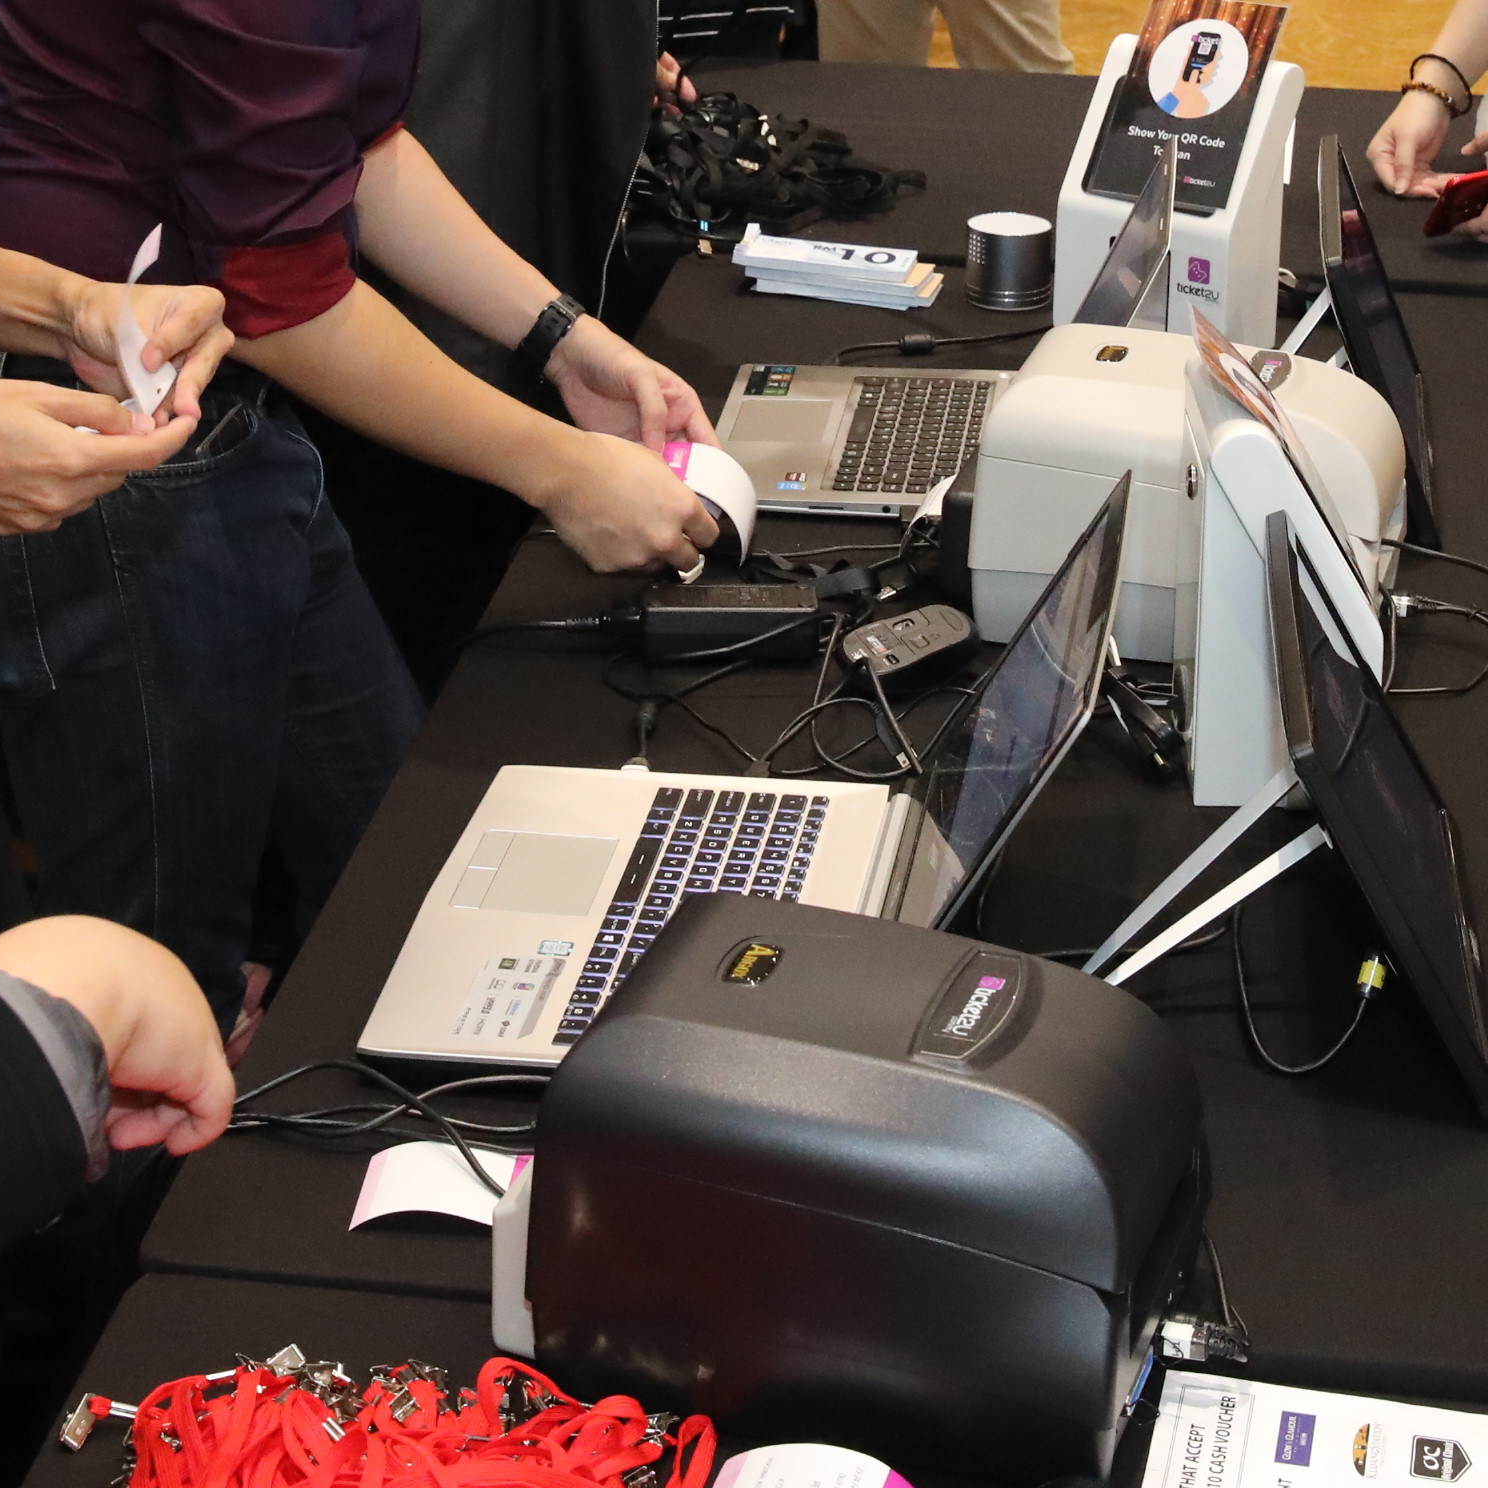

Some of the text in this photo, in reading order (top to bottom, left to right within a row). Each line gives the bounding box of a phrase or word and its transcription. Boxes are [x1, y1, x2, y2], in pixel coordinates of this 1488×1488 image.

[1128, 125, 1156, 139] Show
[1181, 133, 1198, 145] QR
[1199, 136, 1226, 149] Code
[841, 248, 897, 264] 10
[952, 987, 997, 1036] ticket2U
[1215, 1395, 1237, 1444] VOUCHER
[1190, 1423, 1206, 1463] ACCEPT
[1209, 1445, 1228, 1474] CASH
